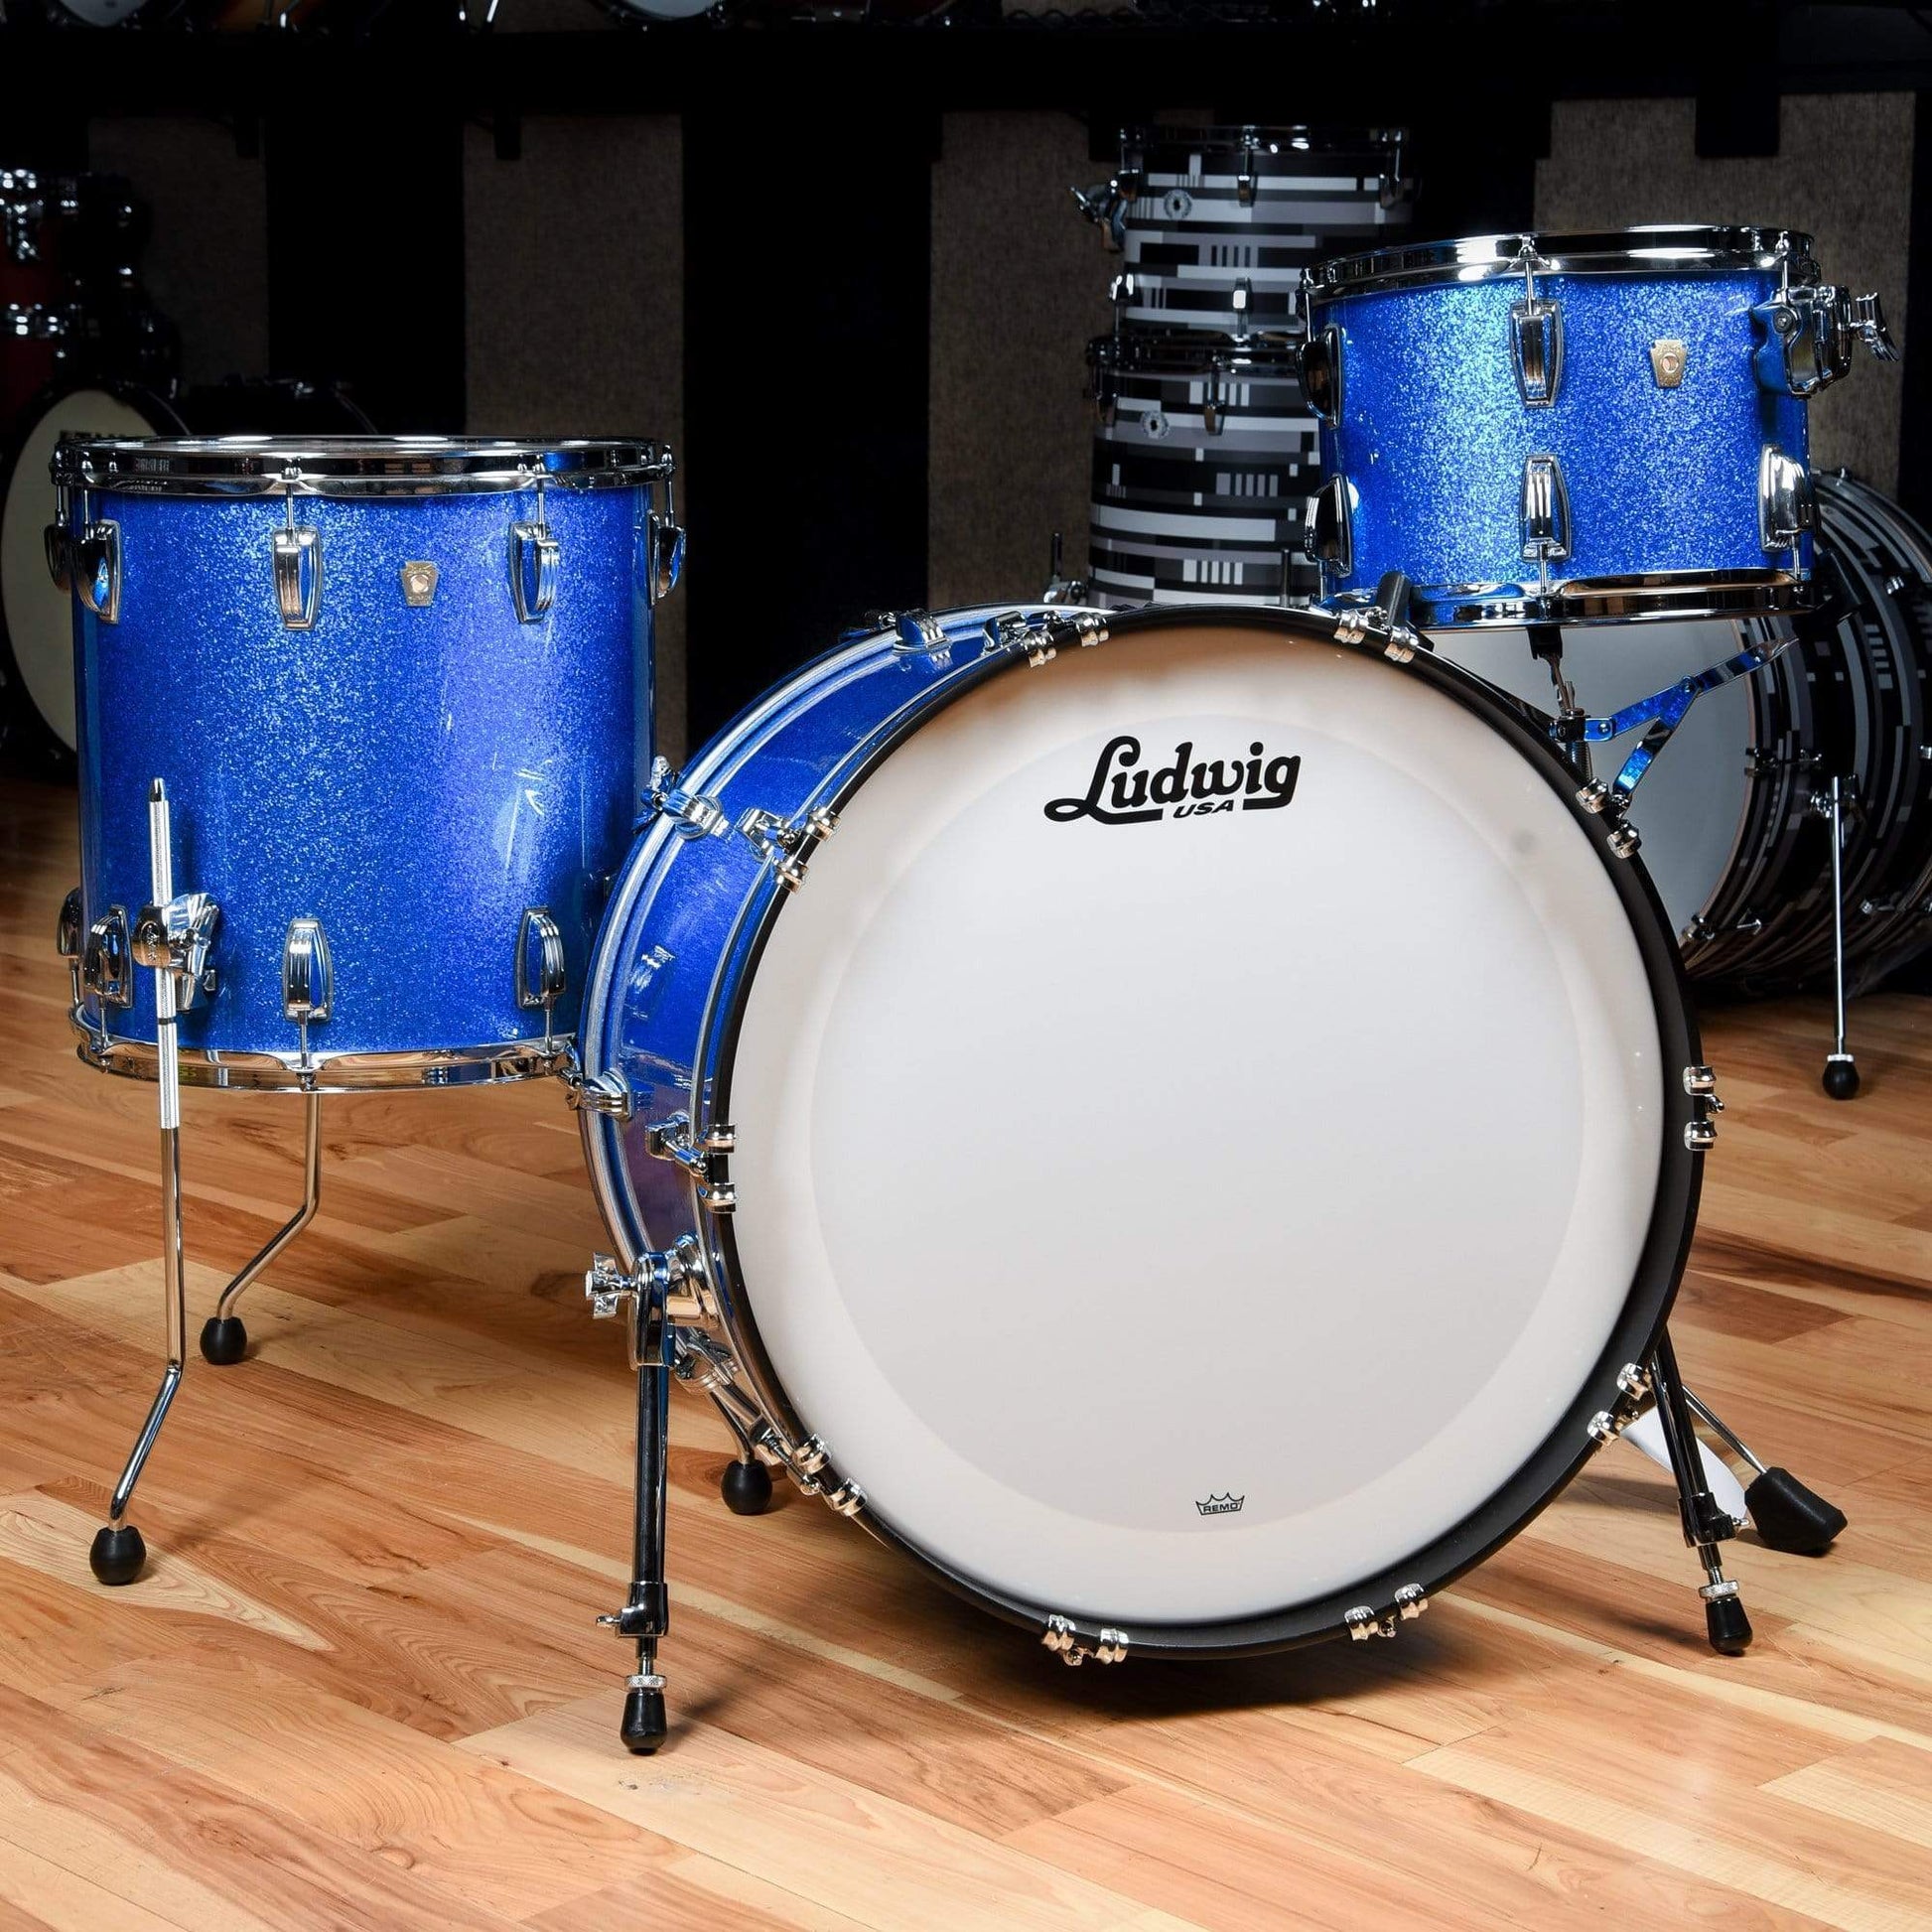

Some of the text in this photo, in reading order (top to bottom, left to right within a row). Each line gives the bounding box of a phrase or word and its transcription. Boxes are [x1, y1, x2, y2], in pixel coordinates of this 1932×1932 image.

[1043, 735, 1302, 825] Ludwig
[1173, 799, 1235, 819] USA
[1203, 1502, 1238, 1513] REMO
